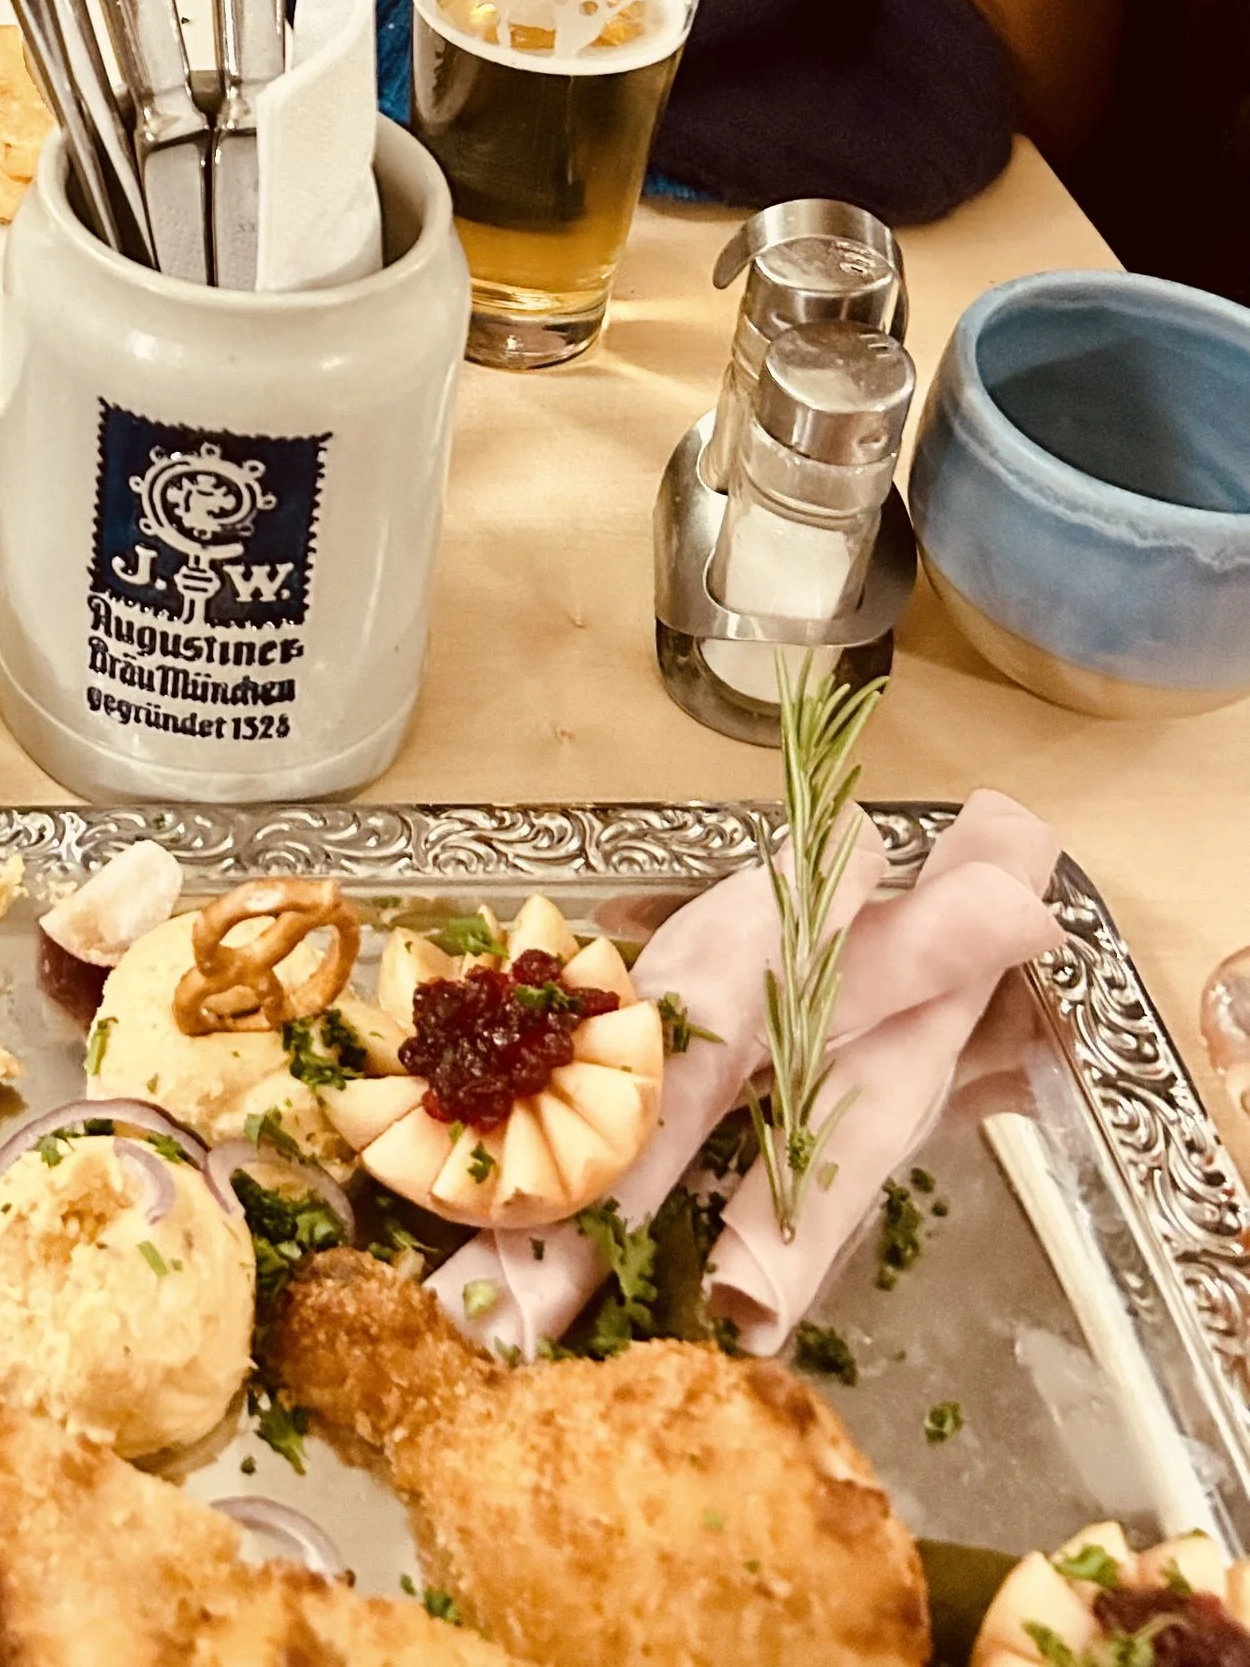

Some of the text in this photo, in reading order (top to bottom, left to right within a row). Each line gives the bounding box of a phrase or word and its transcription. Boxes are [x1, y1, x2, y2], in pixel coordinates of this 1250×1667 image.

[87, 595, 304, 666] Augustiner
[87, 686, 291, 740] gegründet 1528
